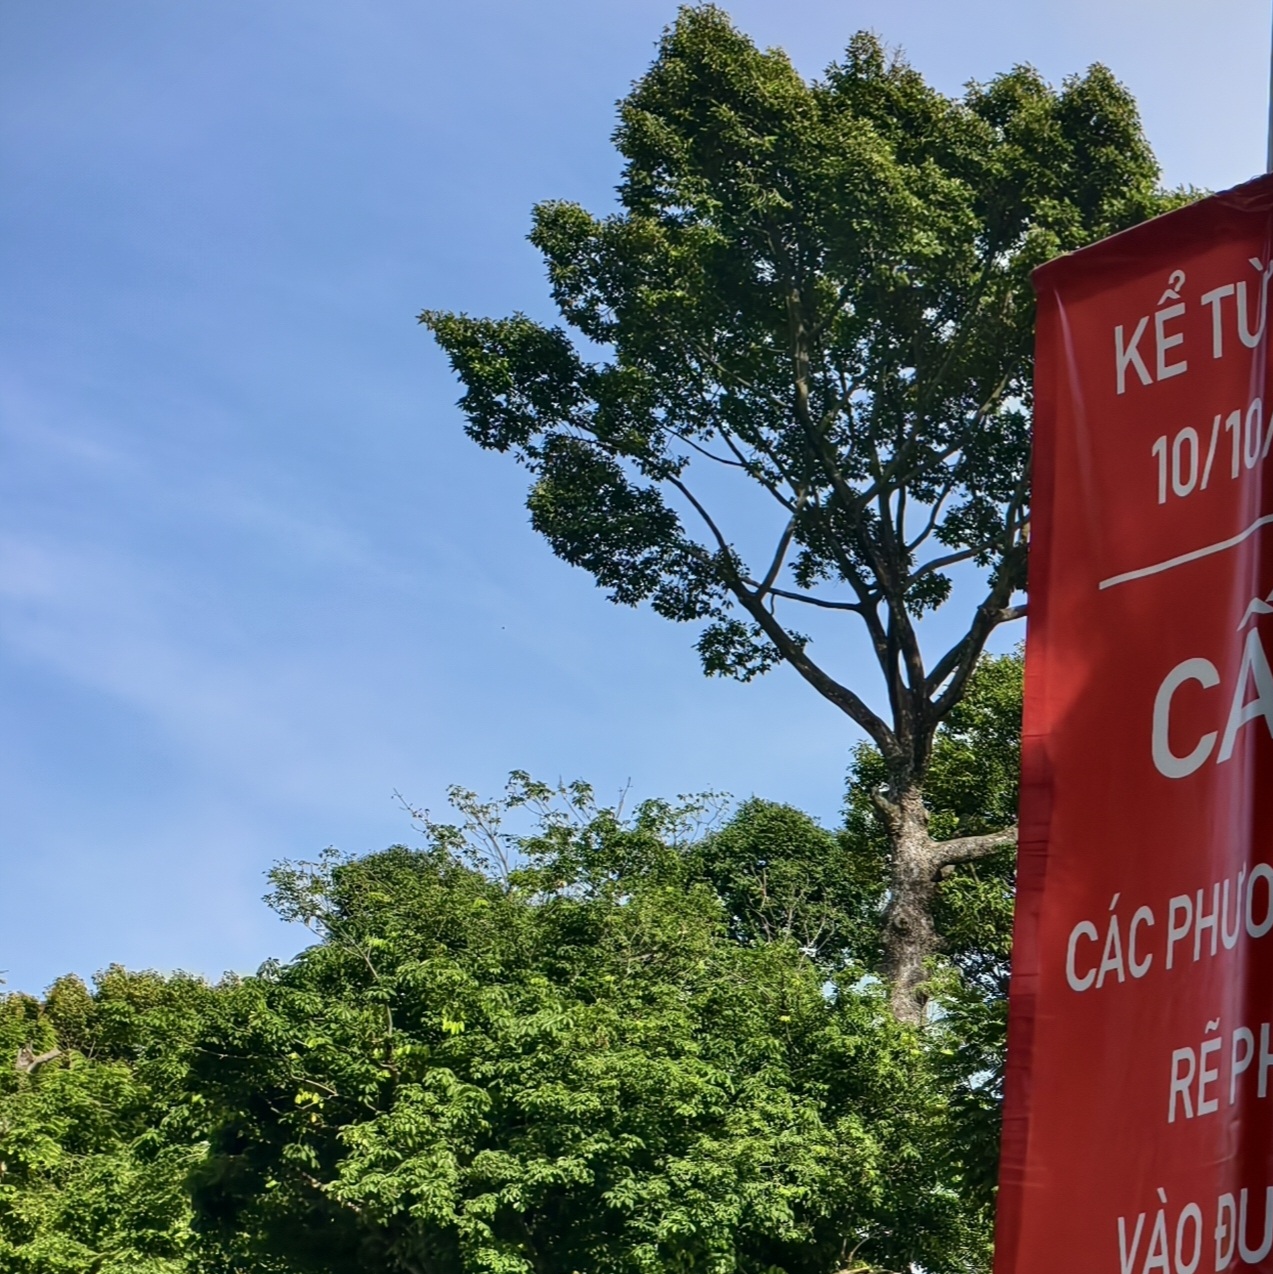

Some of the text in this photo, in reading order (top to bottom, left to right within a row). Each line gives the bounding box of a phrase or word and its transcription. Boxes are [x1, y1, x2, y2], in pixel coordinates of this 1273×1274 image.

[1114, 270, 1187, 394] KỂ
[1066, 893, 1153, 992] CÁC
[1167, 1019, 1221, 1124] RẼ
